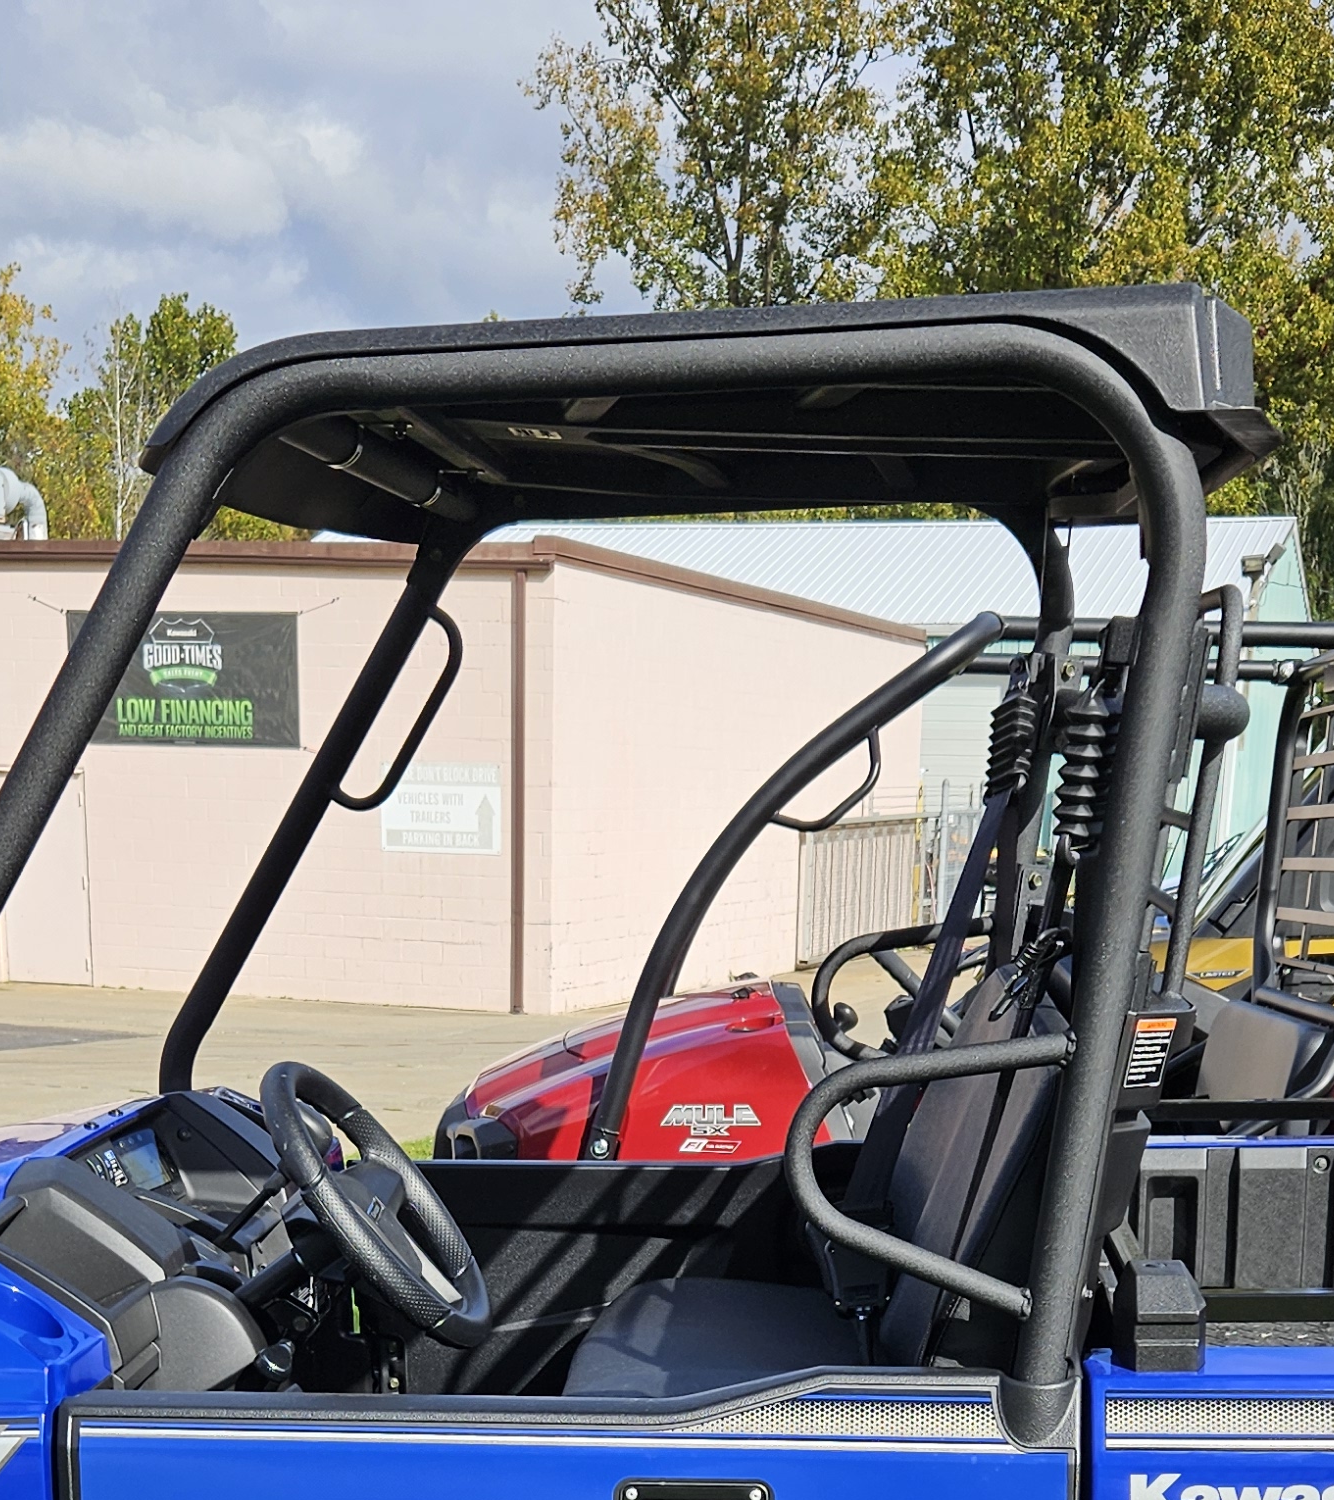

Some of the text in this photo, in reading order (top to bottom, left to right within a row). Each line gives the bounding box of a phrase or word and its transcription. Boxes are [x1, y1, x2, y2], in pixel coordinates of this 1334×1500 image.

[117, 697, 253, 726] LOW FINANCING
[118, 724, 253, 739] AND GREAT FACTORY INCENTIVES
[442, 766, 471, 783] BLOCK
[471, 767, 497, 783] DRIVE
[396, 791, 464, 806] VEHICLES WITH
[410, 810, 452, 825] TRAILERS
[402, 831, 480, 847] PARKING IN BACK
[659, 1103, 762, 1127] MULE
[690, 1125, 730, 1136] SX
